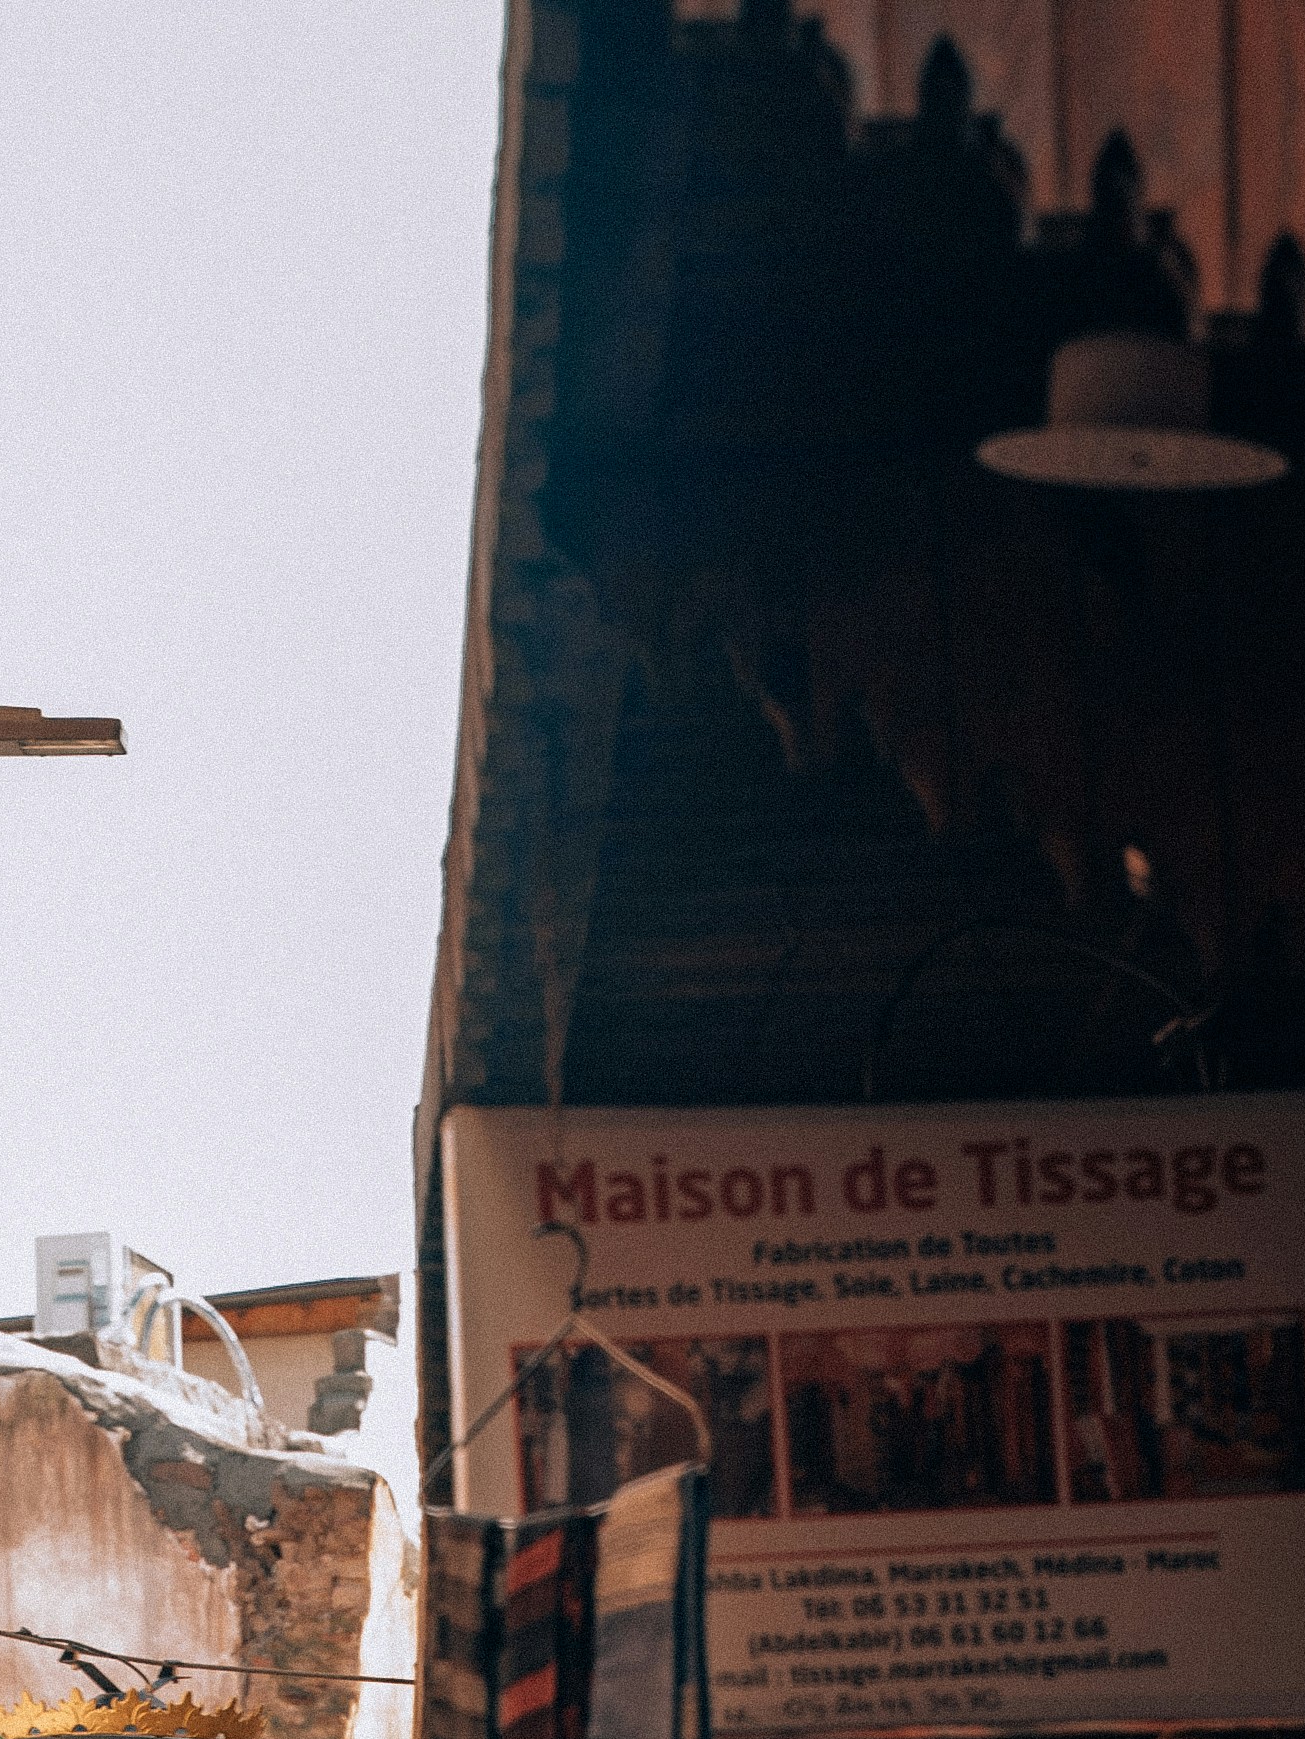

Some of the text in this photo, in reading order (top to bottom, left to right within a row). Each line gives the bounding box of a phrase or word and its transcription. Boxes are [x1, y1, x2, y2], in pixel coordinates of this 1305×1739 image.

[536, 1136, 1267, 1224] Maison de Tissage
[753, 1230, 1057, 1265] Fabrication de Toutes
[667, 1281, 702, 1306] de
[1163, 1256, 1246, 1283] Coton
[1146, 1549, 1221, 1572] Maroc
[852, 1595, 885, 1619] 06
[910, 1624, 942, 1647] 06
